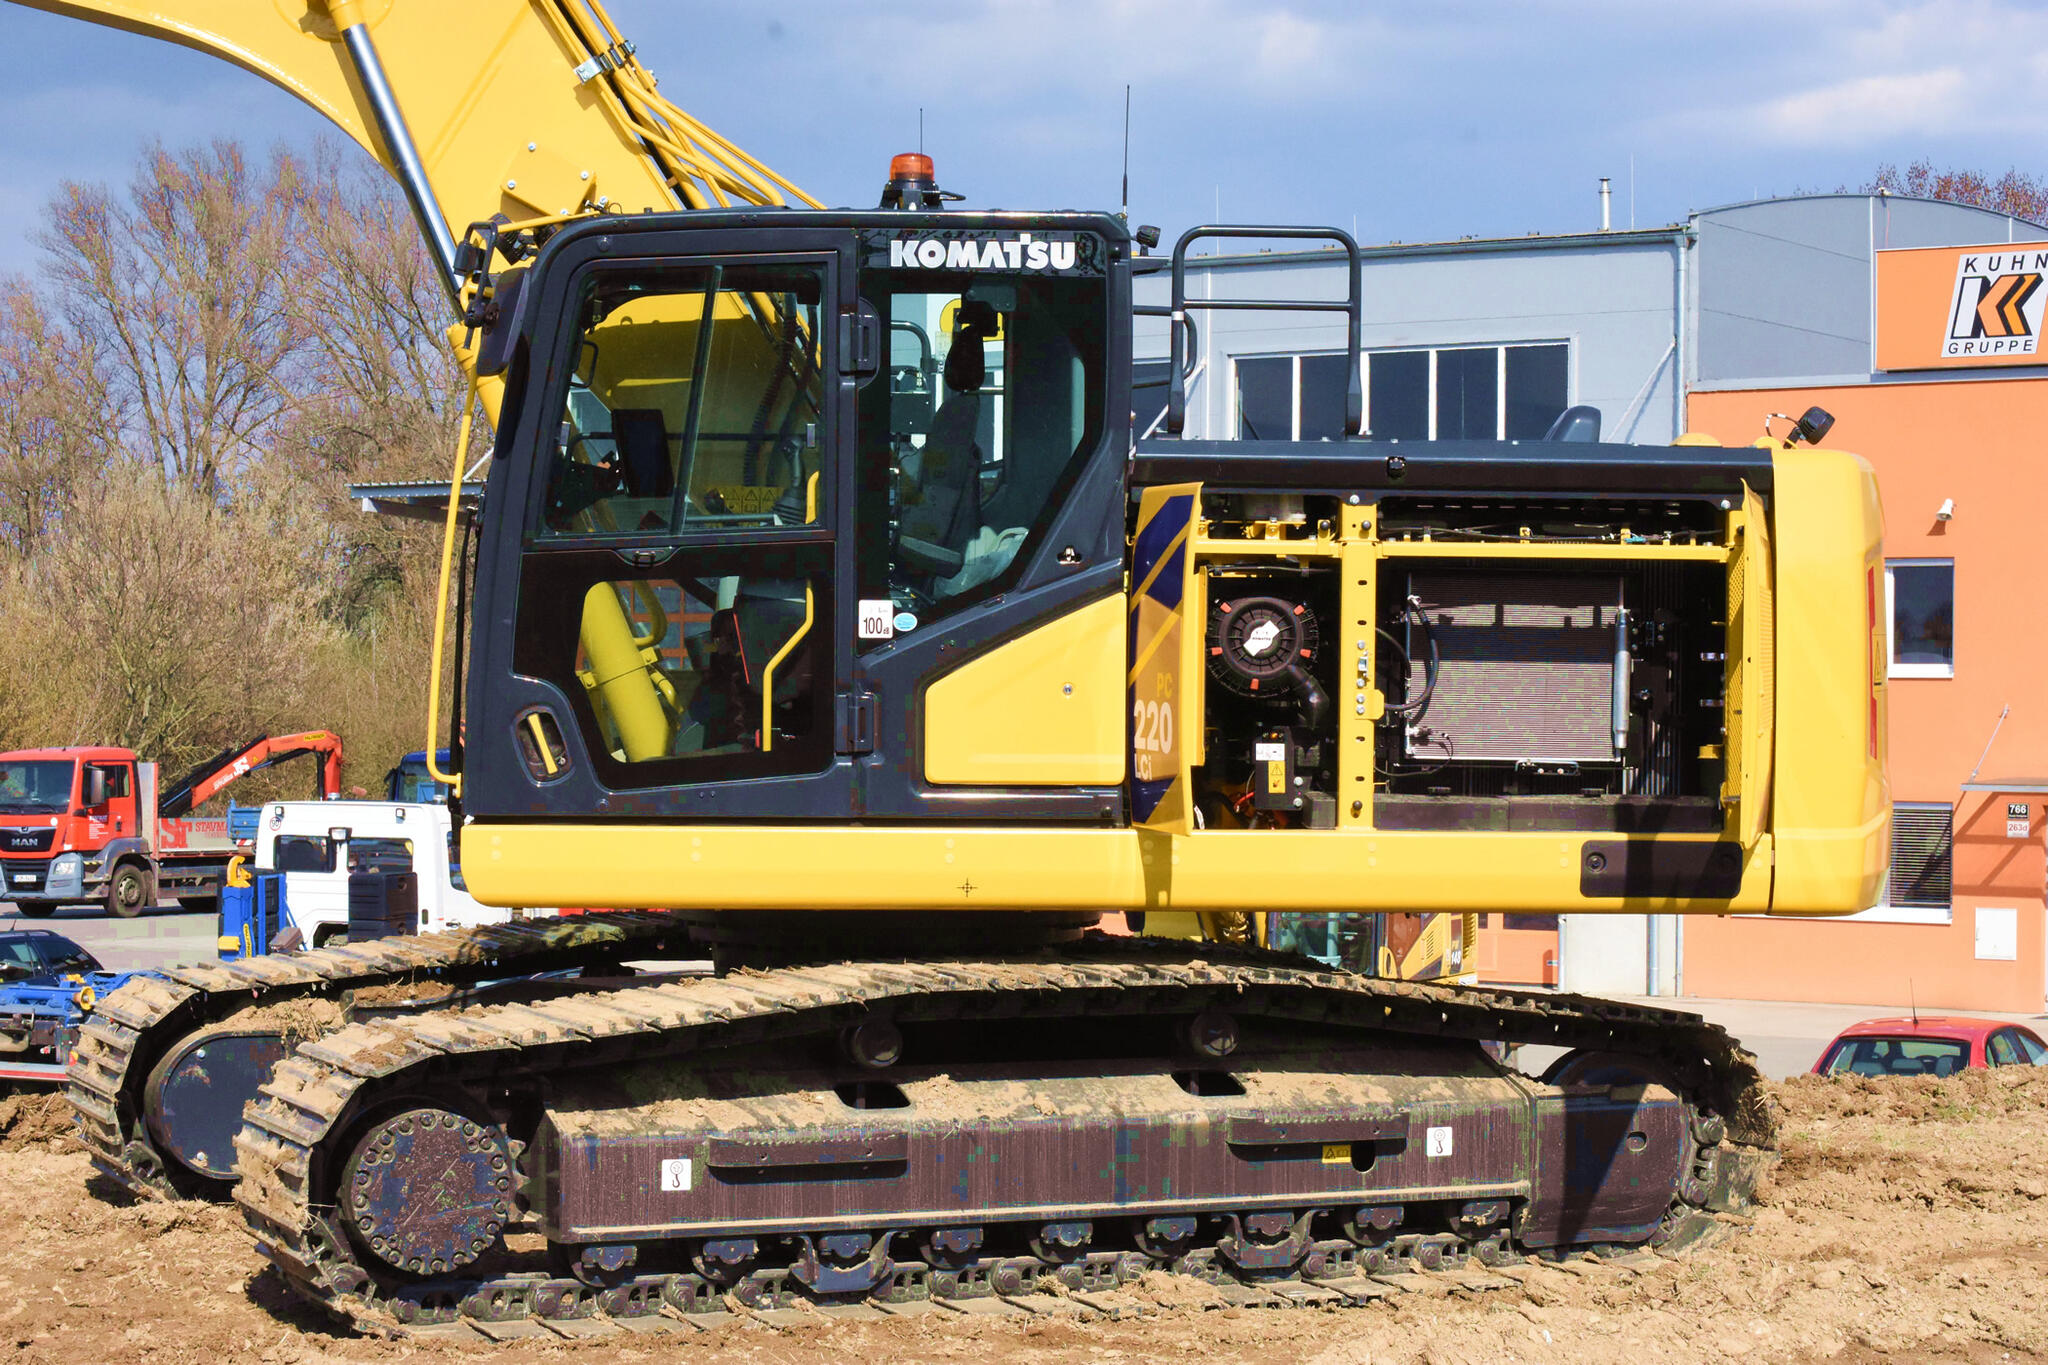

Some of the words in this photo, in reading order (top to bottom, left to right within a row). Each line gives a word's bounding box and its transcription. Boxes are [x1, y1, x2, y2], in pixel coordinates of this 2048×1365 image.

[890, 233, 1076, 270] KOMATSU
[1964, 253, 2048, 273] KUHN
[1948, 340, 2033, 354] GRUPPE
[863, 617, 883, 634] 100
[1157, 672, 1173, 698] PC
[1134, 699, 1173, 754] 220
[2009, 804, 2027, 813] 766
[2009, 824, 2028, 832] 263d
[11, 838, 38, 846] MAN
